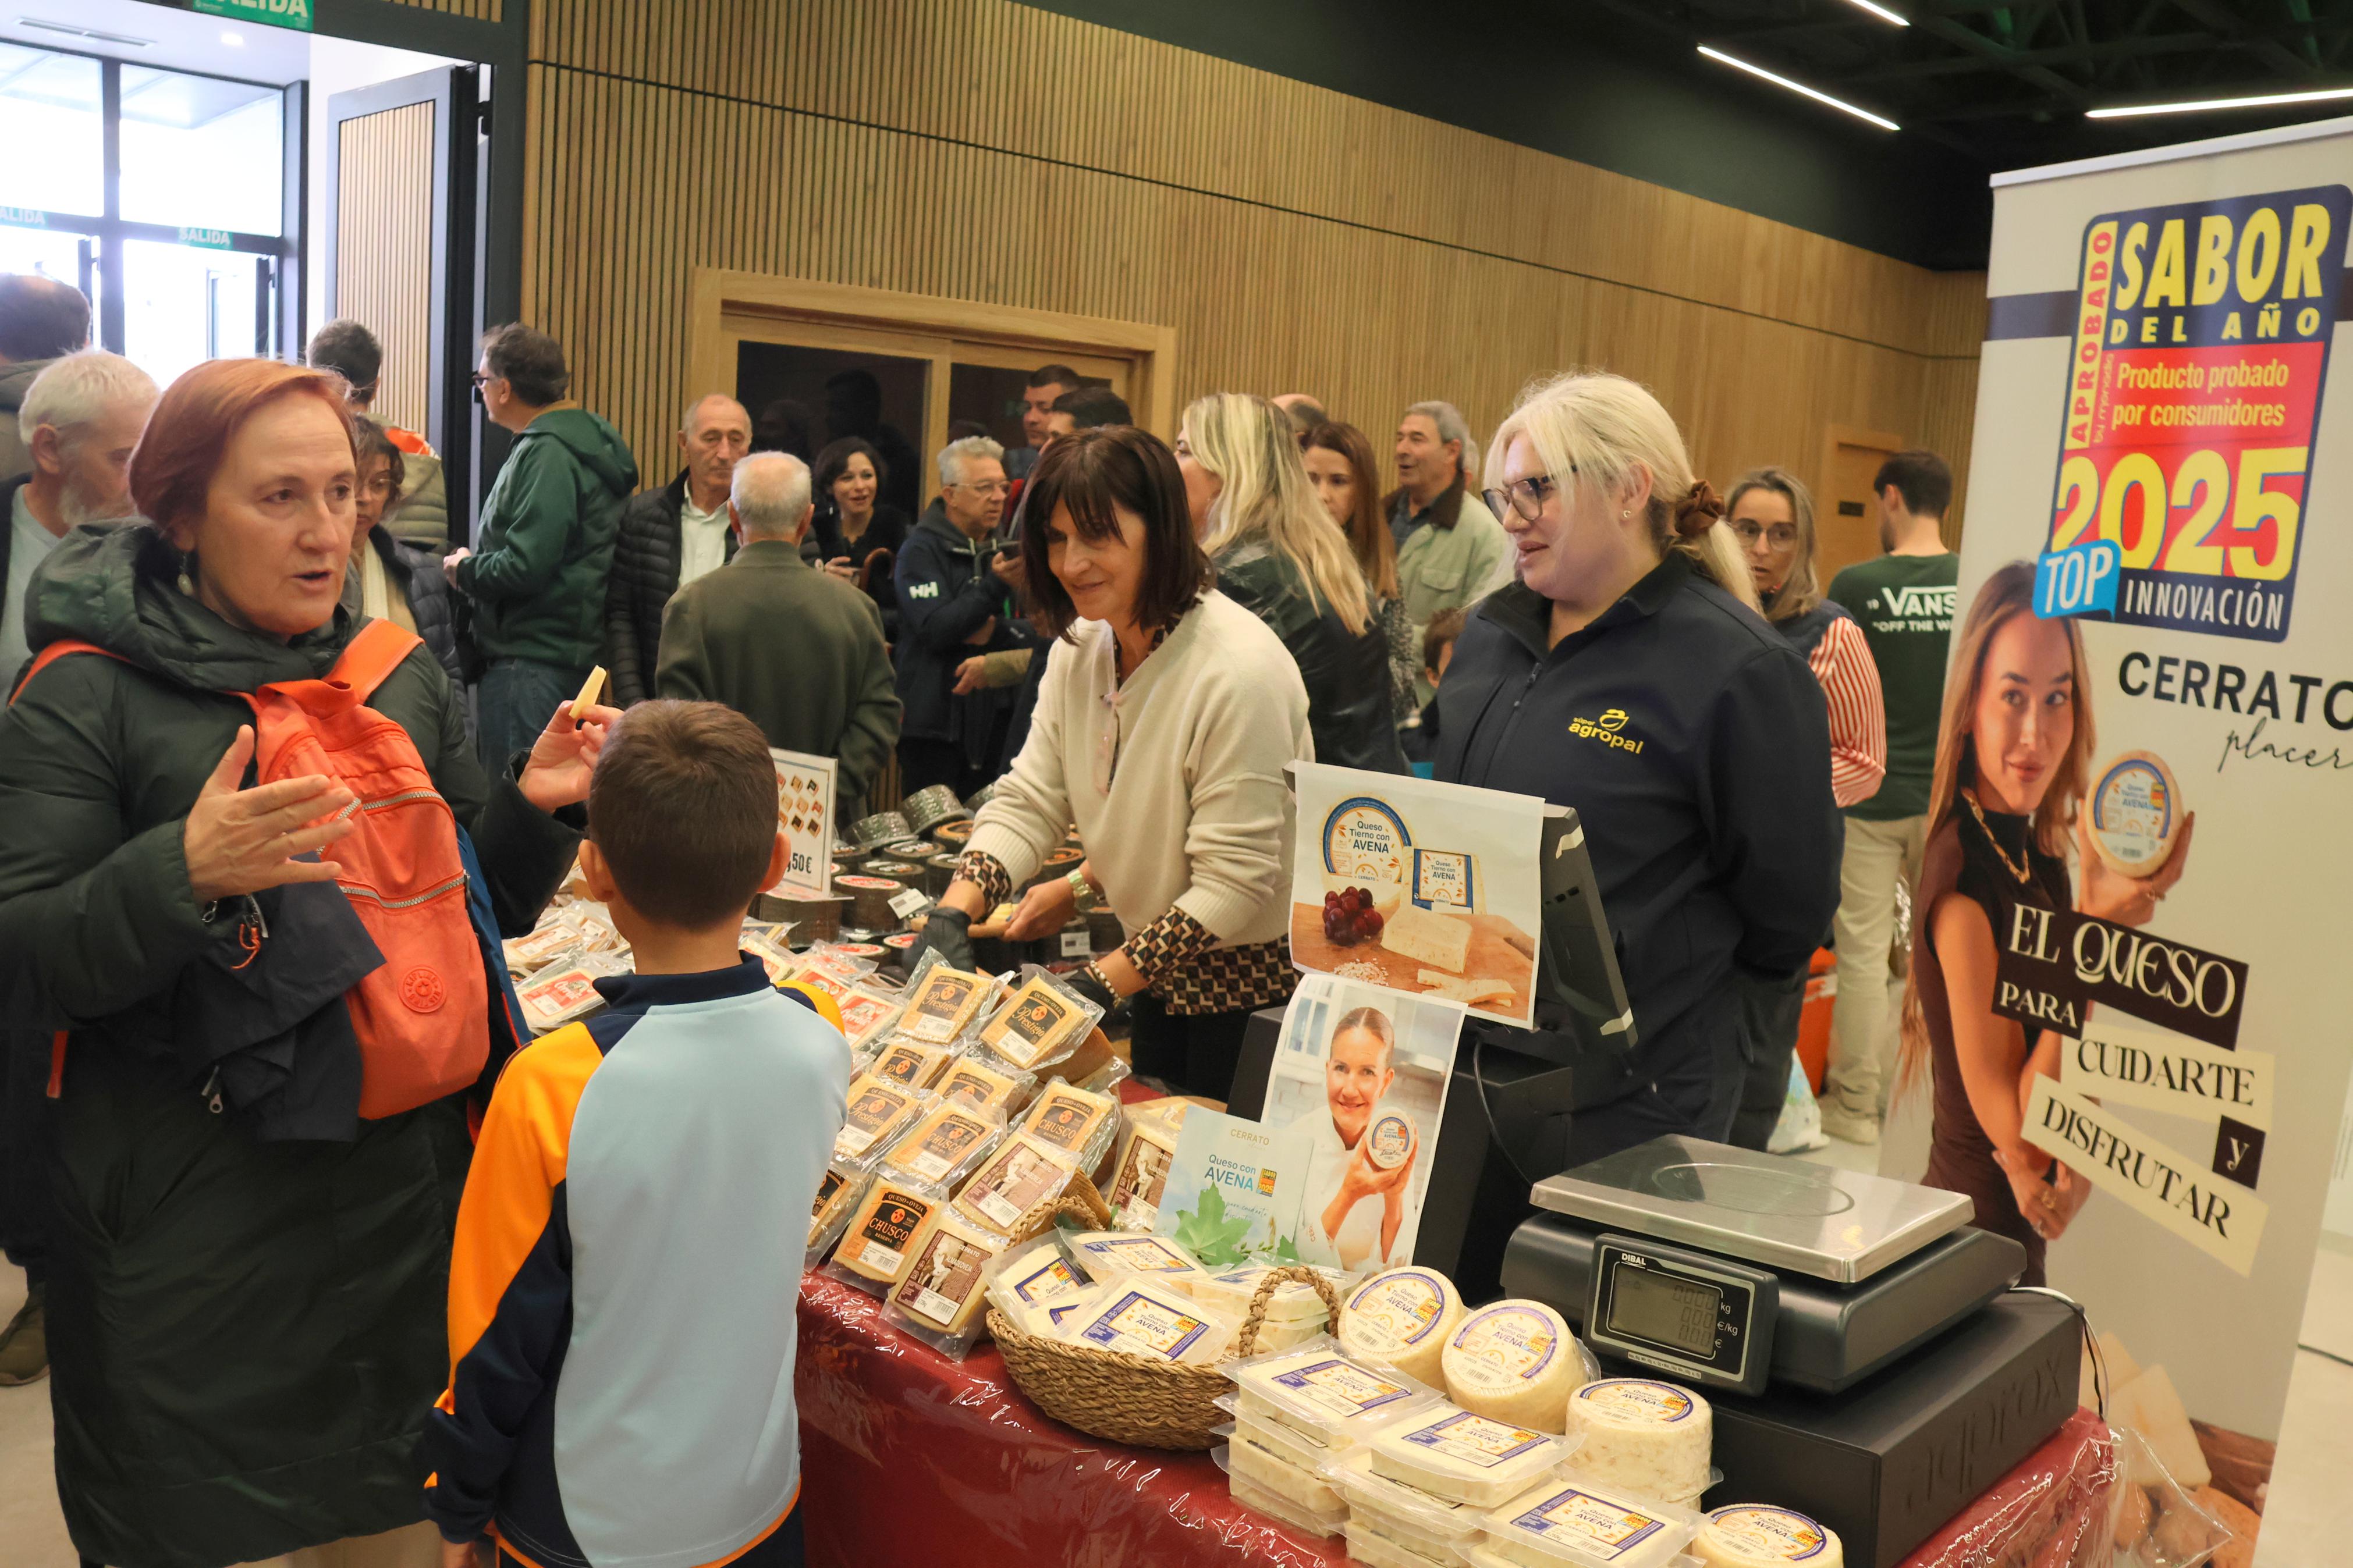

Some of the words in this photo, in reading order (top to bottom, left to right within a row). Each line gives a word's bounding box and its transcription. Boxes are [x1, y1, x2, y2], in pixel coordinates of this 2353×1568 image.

[179, 227, 230, 246] SALIDA
[2115, 204, 2331, 311] SABOR
[2110, 315, 2187, 344] DEL
[2221, 303, 2320, 339] AÑO
[2071, 231, 2113, 444] APROBADO
[2117, 362, 2203, 389] Producto
[2208, 358, 2289, 393] probado
[2111, 403, 2146, 430] por
[2150, 400, 2285, 426] consumidores
[2052, 446, 2308, 581] 2025
[2044, 546, 2113, 613] TOP
[1881, 585, 1957, 617] VANS
[2125, 581, 2284, 630] INNOVACIÓN
[1908, 620, 1934, 632] THE
[2118, 652, 2353, 731] CERRATO
[1568, 723, 1644, 754] agropal
[2122, 798, 2149, 809] AVENA
[1357, 820, 1383, 831] Queso
[1349, 829, 1374, 840] Tierno
[1376, 833, 1390, 841] con
[1353, 840, 1389, 854] AVENA
[1432, 872, 1456, 880] AVENA
[2008, 902, 2061, 963] EL
[2072, 920, 2236, 1017] QUESO
[922, 991, 959, 1012] Prestigio
[1034, 991, 1050, 1004] QUESO
[1999, 981, 2079, 1028] PARA
[1012, 1005, 1045, 1037] Prestigio
[959, 1074, 975, 1083] QUESO
[2077, 1038, 2255, 1107] CUIDARTE
[847, 1102, 884, 1126] Prestigio
[1038, 1119, 1076, 1139] CHUSCO
[927, 1133, 963, 1153] CHUSCO
[1230, 1129, 1269, 1146] CERRATO
[2227, 1136, 2250, 1171] y
[1034, 1158, 1053, 1173] CERRATO
[1209, 1154, 1238, 1169] Queso
[1240, 1164, 1256, 1175] con
[2041, 1096, 2231, 1240] DISFRUTAR
[1204, 1166, 1254, 1192] AVENA
[1258, 1183, 1273, 1193] 2025
[888, 1194, 906, 1203] QUESO
[908, 1201, 924, 1213] OVEJA
[869, 1217, 909, 1242] CHUSCO
[875, 1232, 893, 1243] RESERVA
[958, 1244, 980, 1258] CERRATO
[1621, 1252, 1646, 1265] DIBAL
[1045, 1284, 1060, 1294] Queso
[1391, 1289, 1408, 1302] Tierno
[1400, 1288, 1418, 1300] Queso
[1386, 1296, 1412, 1314] AVENA
[1720, 1302, 1731, 1314] kg
[1140, 1314, 1158, 1326] Tierno
[1148, 1313, 1169, 1325] Queso
[1182, 1315, 1199, 1327] SABOR
[1415, 1308, 1432, 1321] 2025
[1135, 1319, 1167, 1335] AVENA
[1173, 1322, 1193, 1334] 2025
[1497, 1324, 1517, 1336] Tierno
[1507, 1322, 1527, 1334] Queso
[1717, 1321, 1738, 1336] €/kg
[1126, 1332, 1147, 1343] CERRATO
[1492, 1331, 1524, 1349] AVENA
[1715, 1339, 1723, 1348] €
[1525, 1341, 1546, 1352] 2025
[1481, 1356, 1499, 1367] CERRATO
[1333, 1377, 1364, 1392] AVENA
[1347, 1375, 1367, 1386] Queso
[1621, 1393, 1657, 1406] AVENA
[1623, 1389, 1648, 1399] Tierno
[1633, 1389, 1658, 1398] Queso
[1467, 1430, 1500, 1444] AVENA
[1481, 1427, 1503, 1437] Queso
[1574, 1513, 1613, 1530] AVENA
[1580, 1509, 1605, 1521] Tierno
[1605, 1519, 1618, 1527] con
[1589, 1509, 1614, 1521] Queso
[1633, 1513, 1653, 1524] SABOR
[1621, 1518, 1645, 1531] 2025
[1752, 1521, 1788, 1538] AVENA
[1756, 1517, 1780, 1528] Tierno
[1768, 1517, 1791, 1529] Queso
